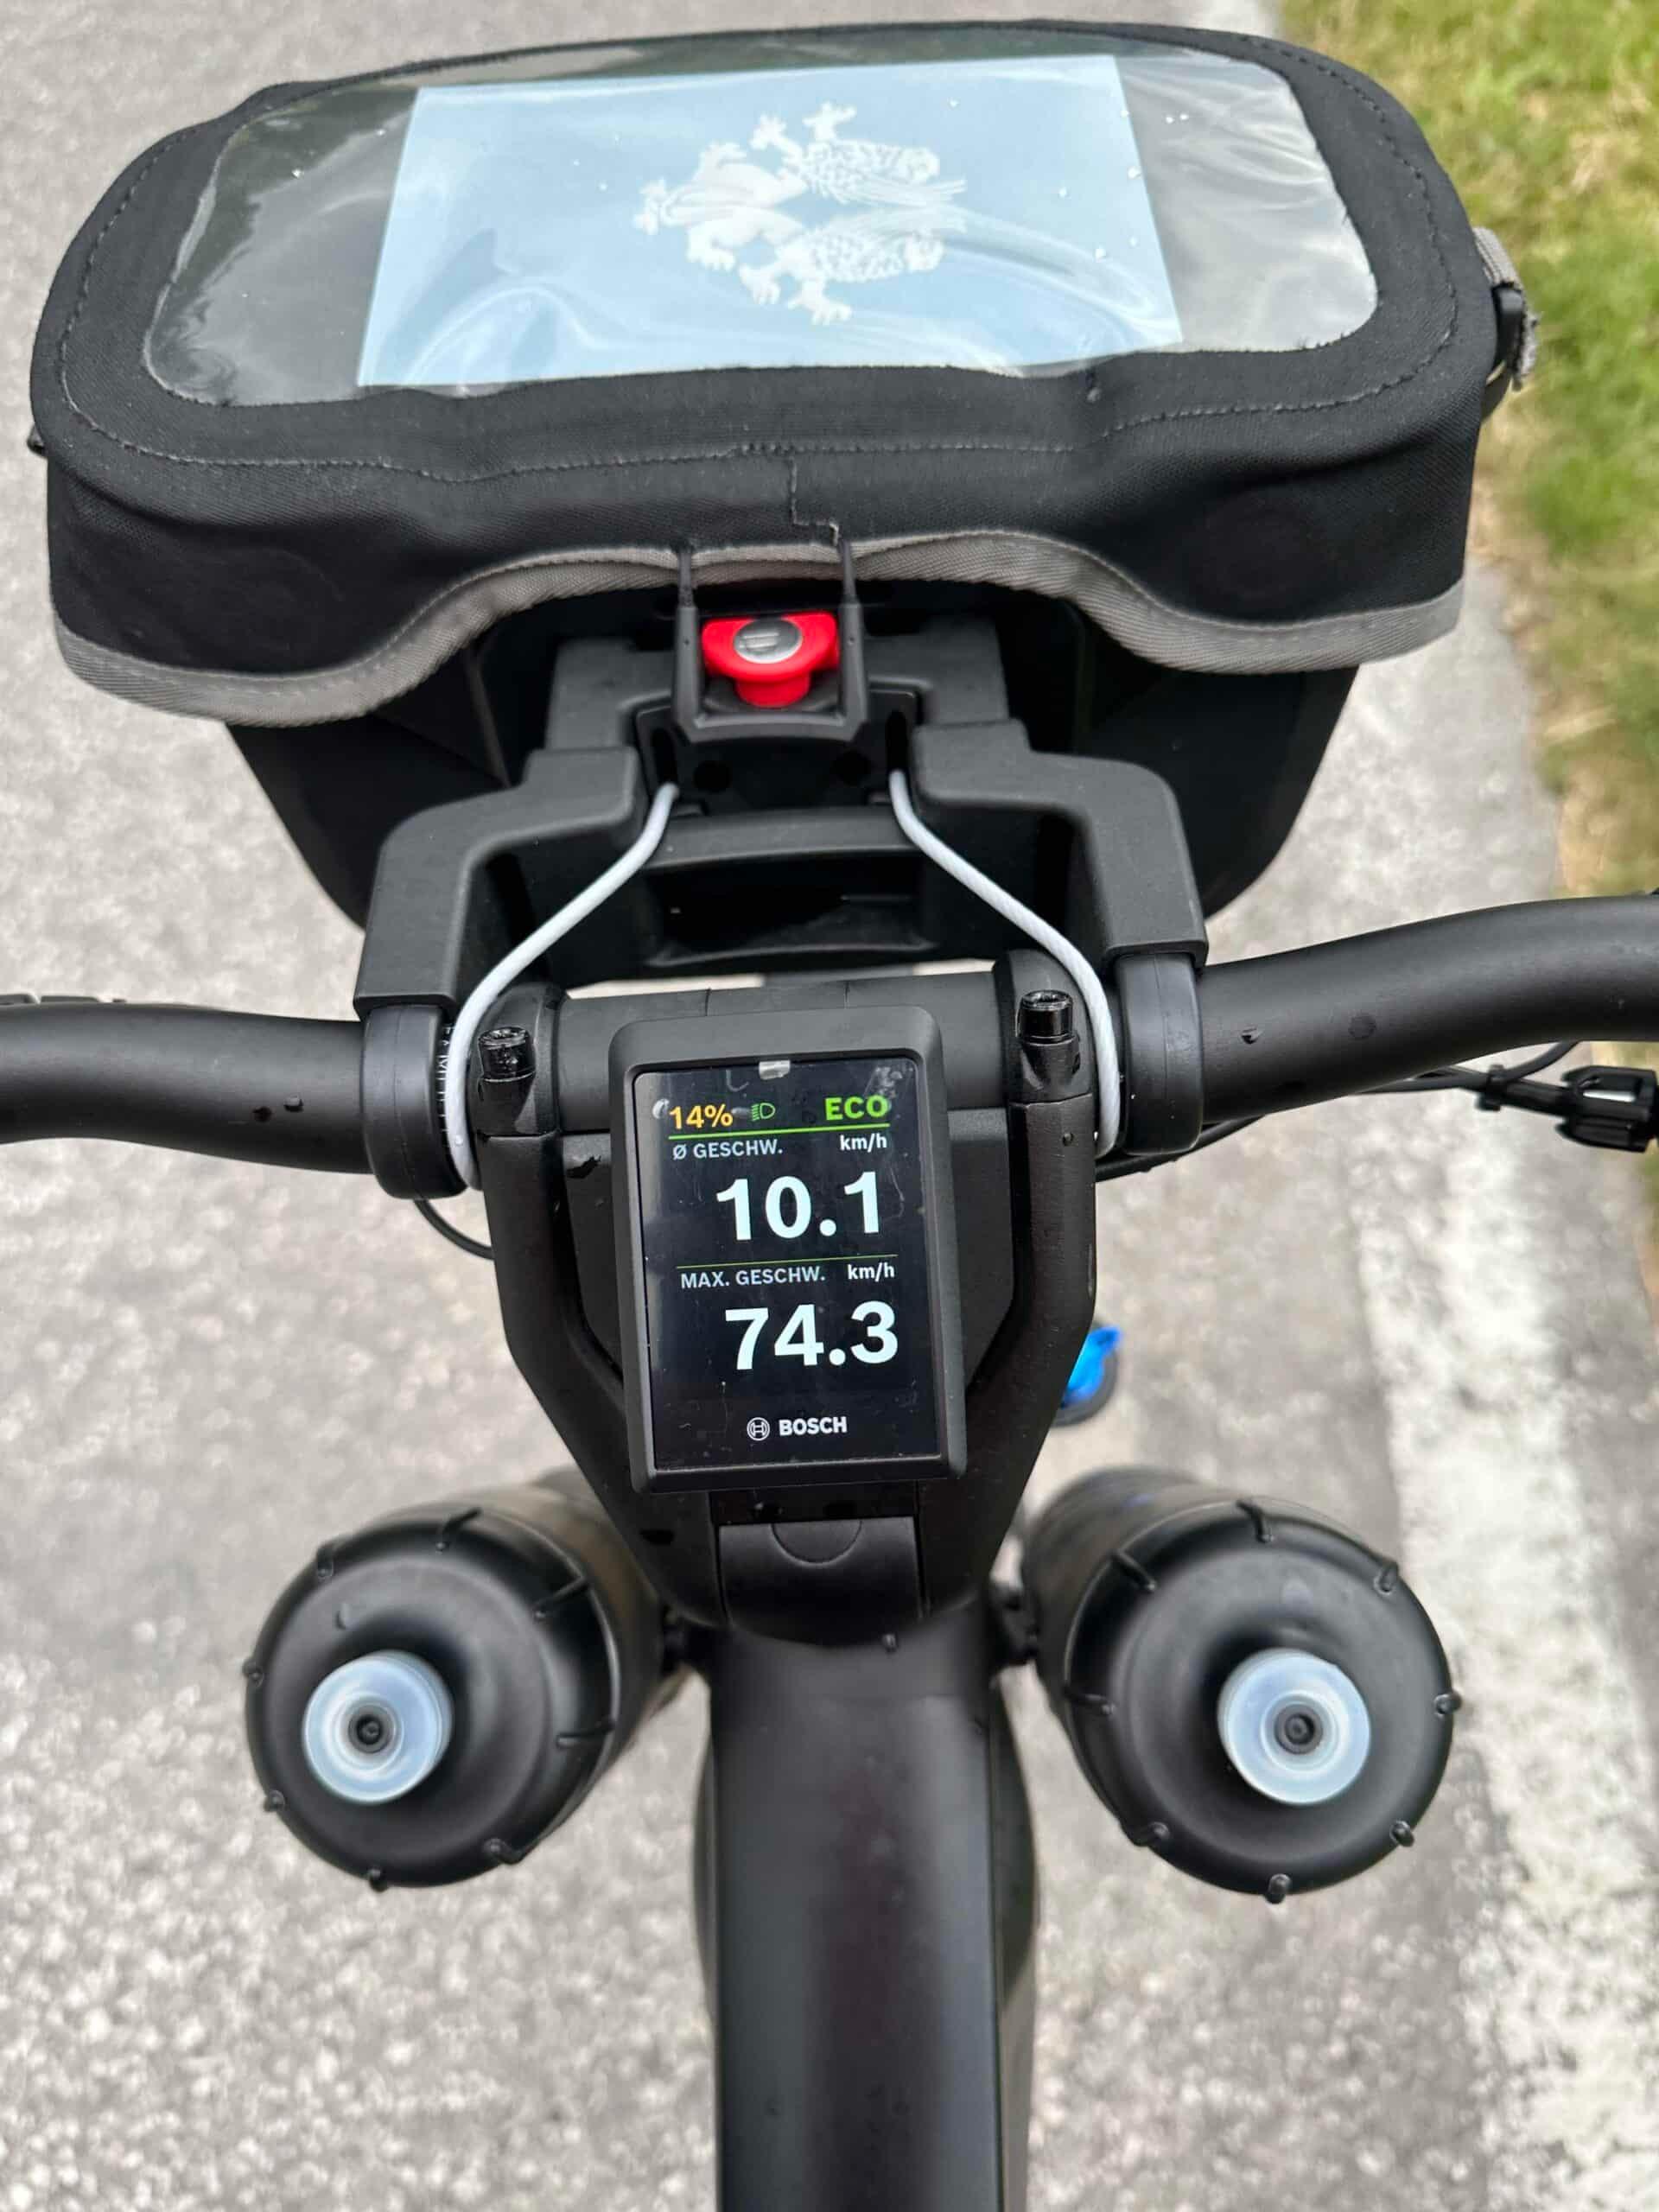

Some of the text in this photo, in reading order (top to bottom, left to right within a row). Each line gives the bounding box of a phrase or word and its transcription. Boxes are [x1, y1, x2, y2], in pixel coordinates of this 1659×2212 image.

[669, 1103, 734, 1130] 14%
[825, 1094, 889, 1121] ECO
[693, 1139, 784, 1160] GESCHW.
[840, 1133, 888, 1154] km/h
[715, 1171, 880, 1241] 10.1
[680, 1265, 826, 1289] MAX. GESCHW.
[848, 1262, 895, 1282] km/h
[725, 1300, 899, 1370] 74.3
[779, 1416, 848, 1437] BOSCH
